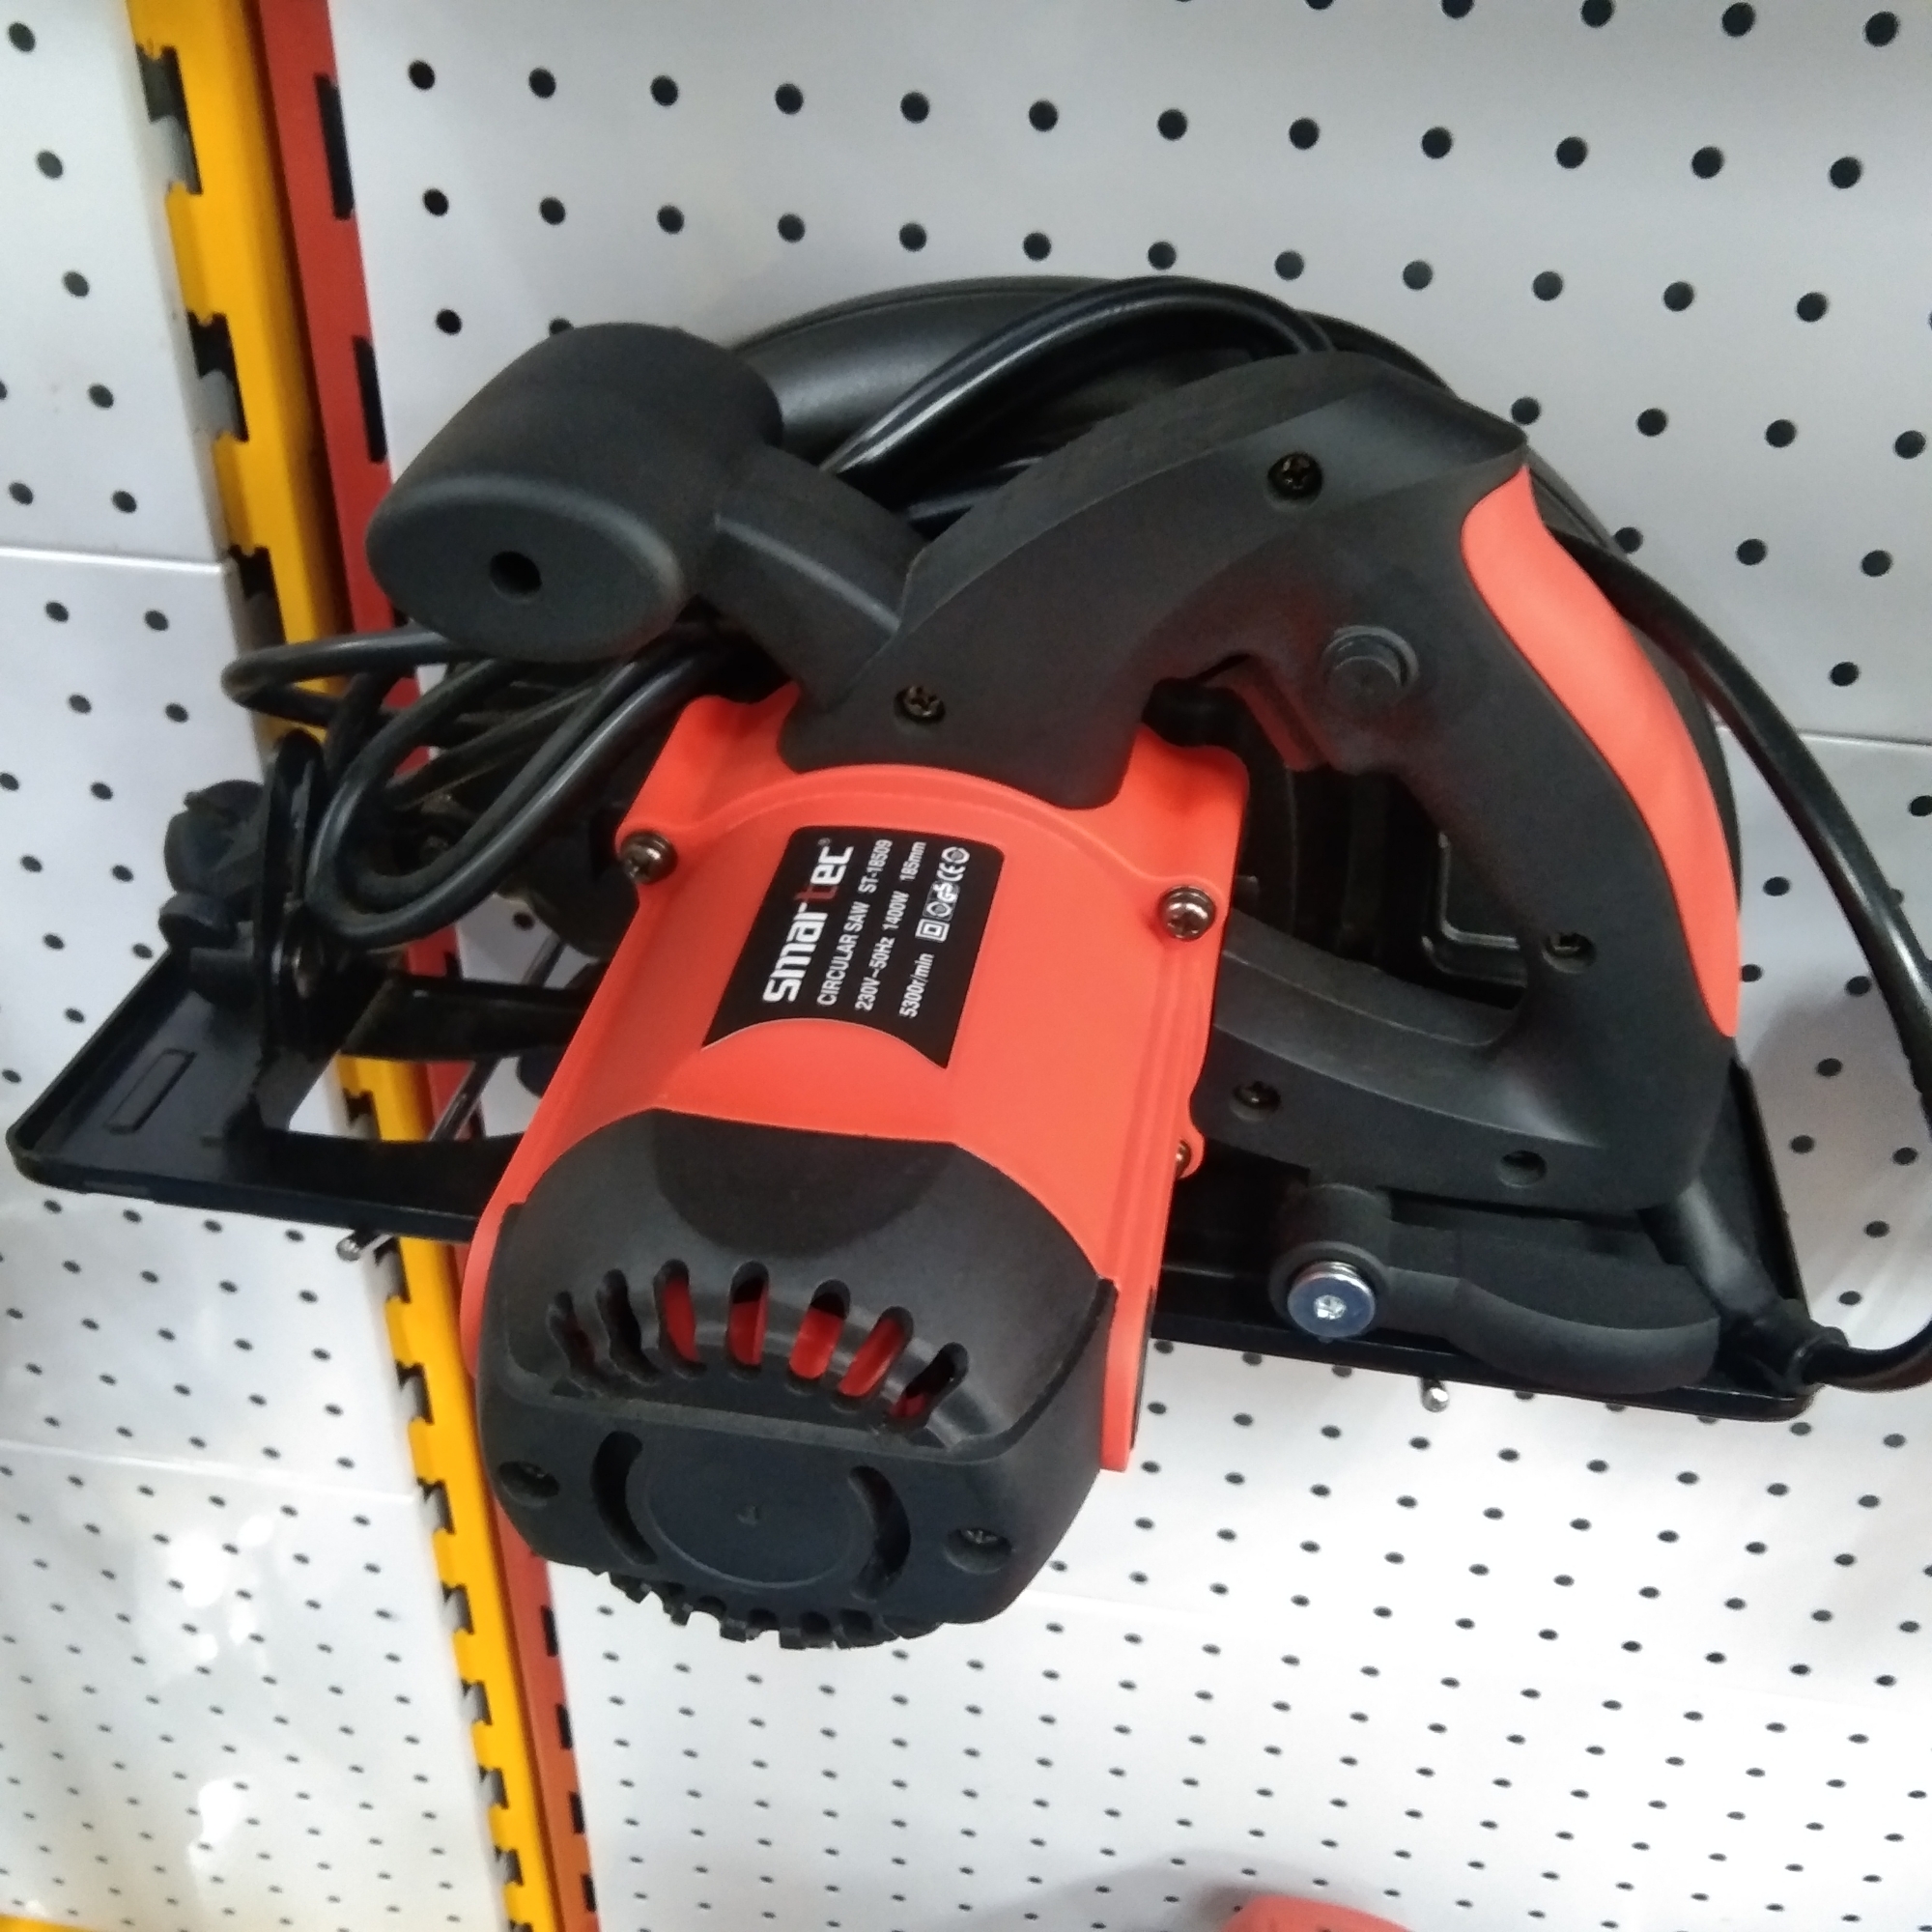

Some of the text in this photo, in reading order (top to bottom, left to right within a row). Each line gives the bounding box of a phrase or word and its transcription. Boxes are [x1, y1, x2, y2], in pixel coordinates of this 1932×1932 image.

[762, 845, 854, 1002] smartec
[883, 891, 909, 931] 1400W
[899, 841, 926, 881] 185mm
[817, 932, 859, 1006] CIRCULAR
[844, 901, 869, 932] SAW
[899, 953, 934, 1018] 5300r/min
